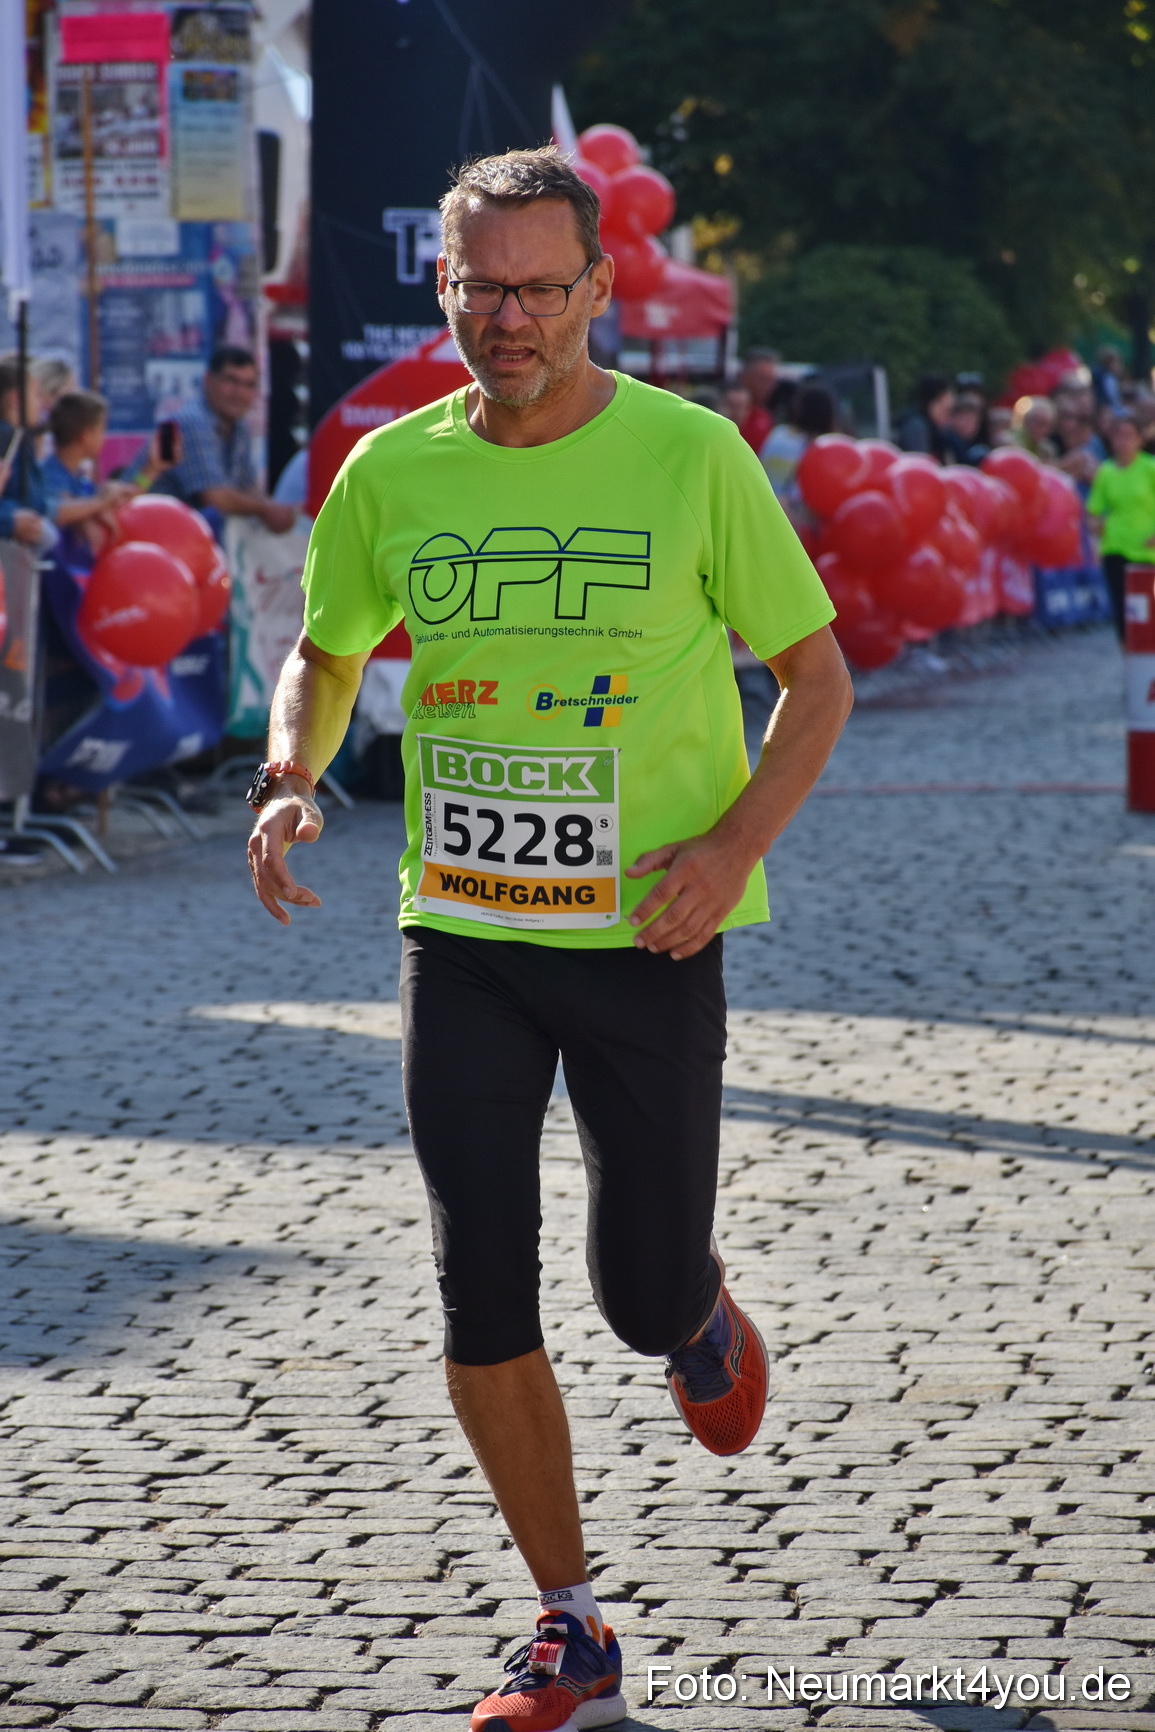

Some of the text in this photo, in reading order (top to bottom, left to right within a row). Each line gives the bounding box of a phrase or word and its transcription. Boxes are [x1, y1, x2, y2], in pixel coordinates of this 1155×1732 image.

[451, 629, 470, 639] und
[473, 626, 604, 638] Automatisierungstechnik
[608, 627, 643, 639] GmbH
[419, 680, 499, 706] MERZ
[535, 691, 639, 711] Bretschneider
[412, 697, 476, 720] Reisen
[432, 745, 600, 796] BOCK
[443, 802, 594, 867] 5228
[600, 818, 608, 828] S
[440, 872, 596, 906] WOLFGANG
